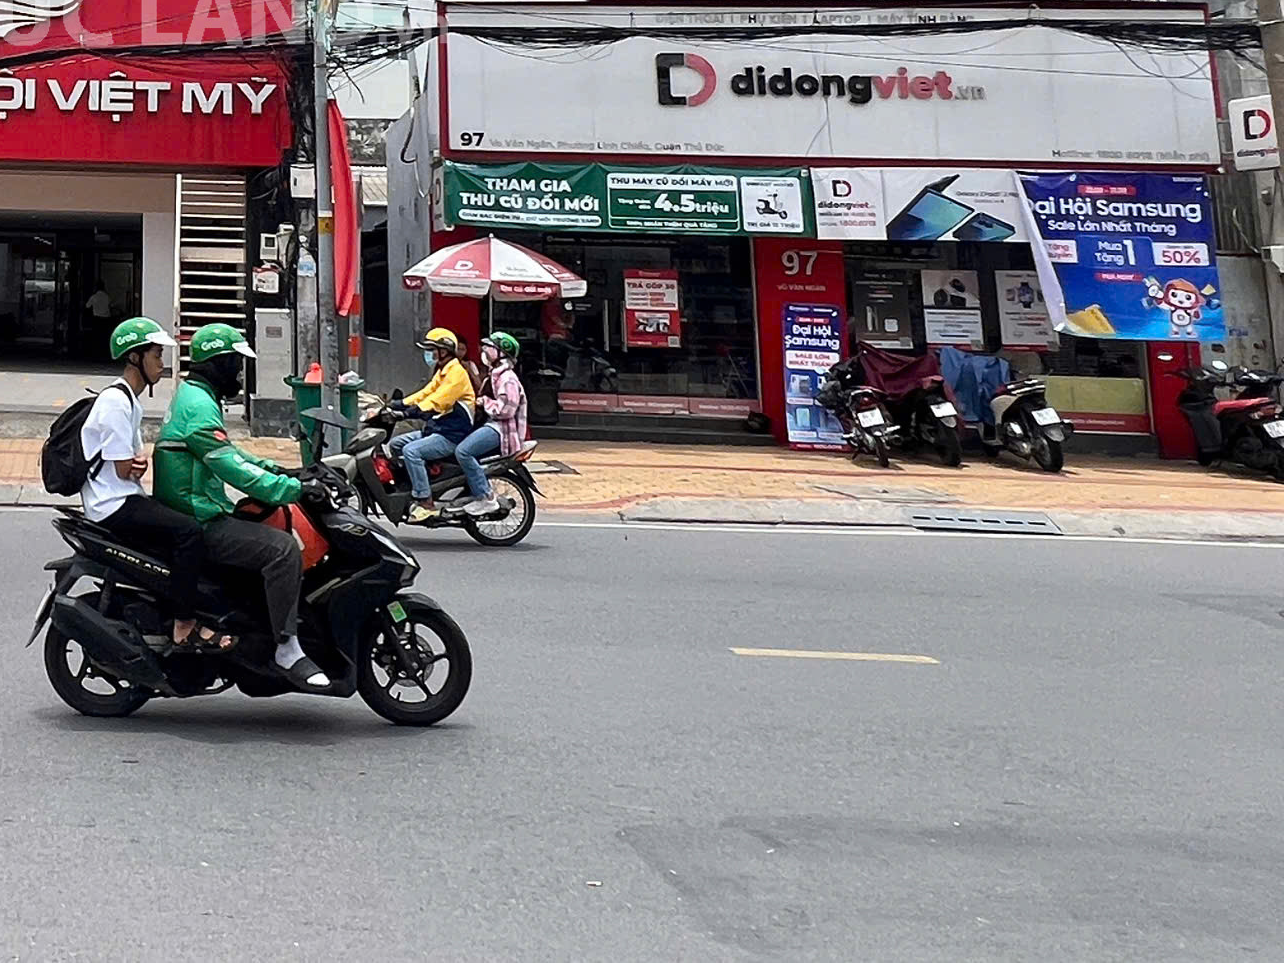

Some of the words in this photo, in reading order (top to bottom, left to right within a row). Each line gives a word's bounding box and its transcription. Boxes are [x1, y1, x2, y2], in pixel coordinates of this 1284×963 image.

[47, 71, 172, 122] VIỆT
[181, 76, 278, 115] MỸ
[460, 132, 485, 147] 97
[484, 178, 535, 192] THAM
[540, 179, 572, 192] GIA
[611, 177, 630, 185] THU
[633, 176, 653, 185] MÁY
[656, 176, 668, 186] CŨ
[691, 178, 712, 186] MÁY
[459, 192, 495, 206] THU
[499, 195, 523, 209] CŨ
[526, 193, 560, 210] ĐỔI
[564, 195, 600, 211] MỚI
[1059, 197, 1093, 220] Hội
[1096, 199, 1203, 223] Samsung
[1047, 219, 1076, 231] Sale
[1101, 219, 1132, 232] Nhất
[1135, 221, 1177, 236] Tháng
[1098, 241, 1123, 251] Mua
[781, 250, 818, 276] 97
[1094, 251, 1125, 266] Tặng
[1162, 250, 1201, 265] 50%
[117, 332, 138, 346] Grab
[201, 338, 225, 351] Grab
[785, 335, 840, 350] Samsung
